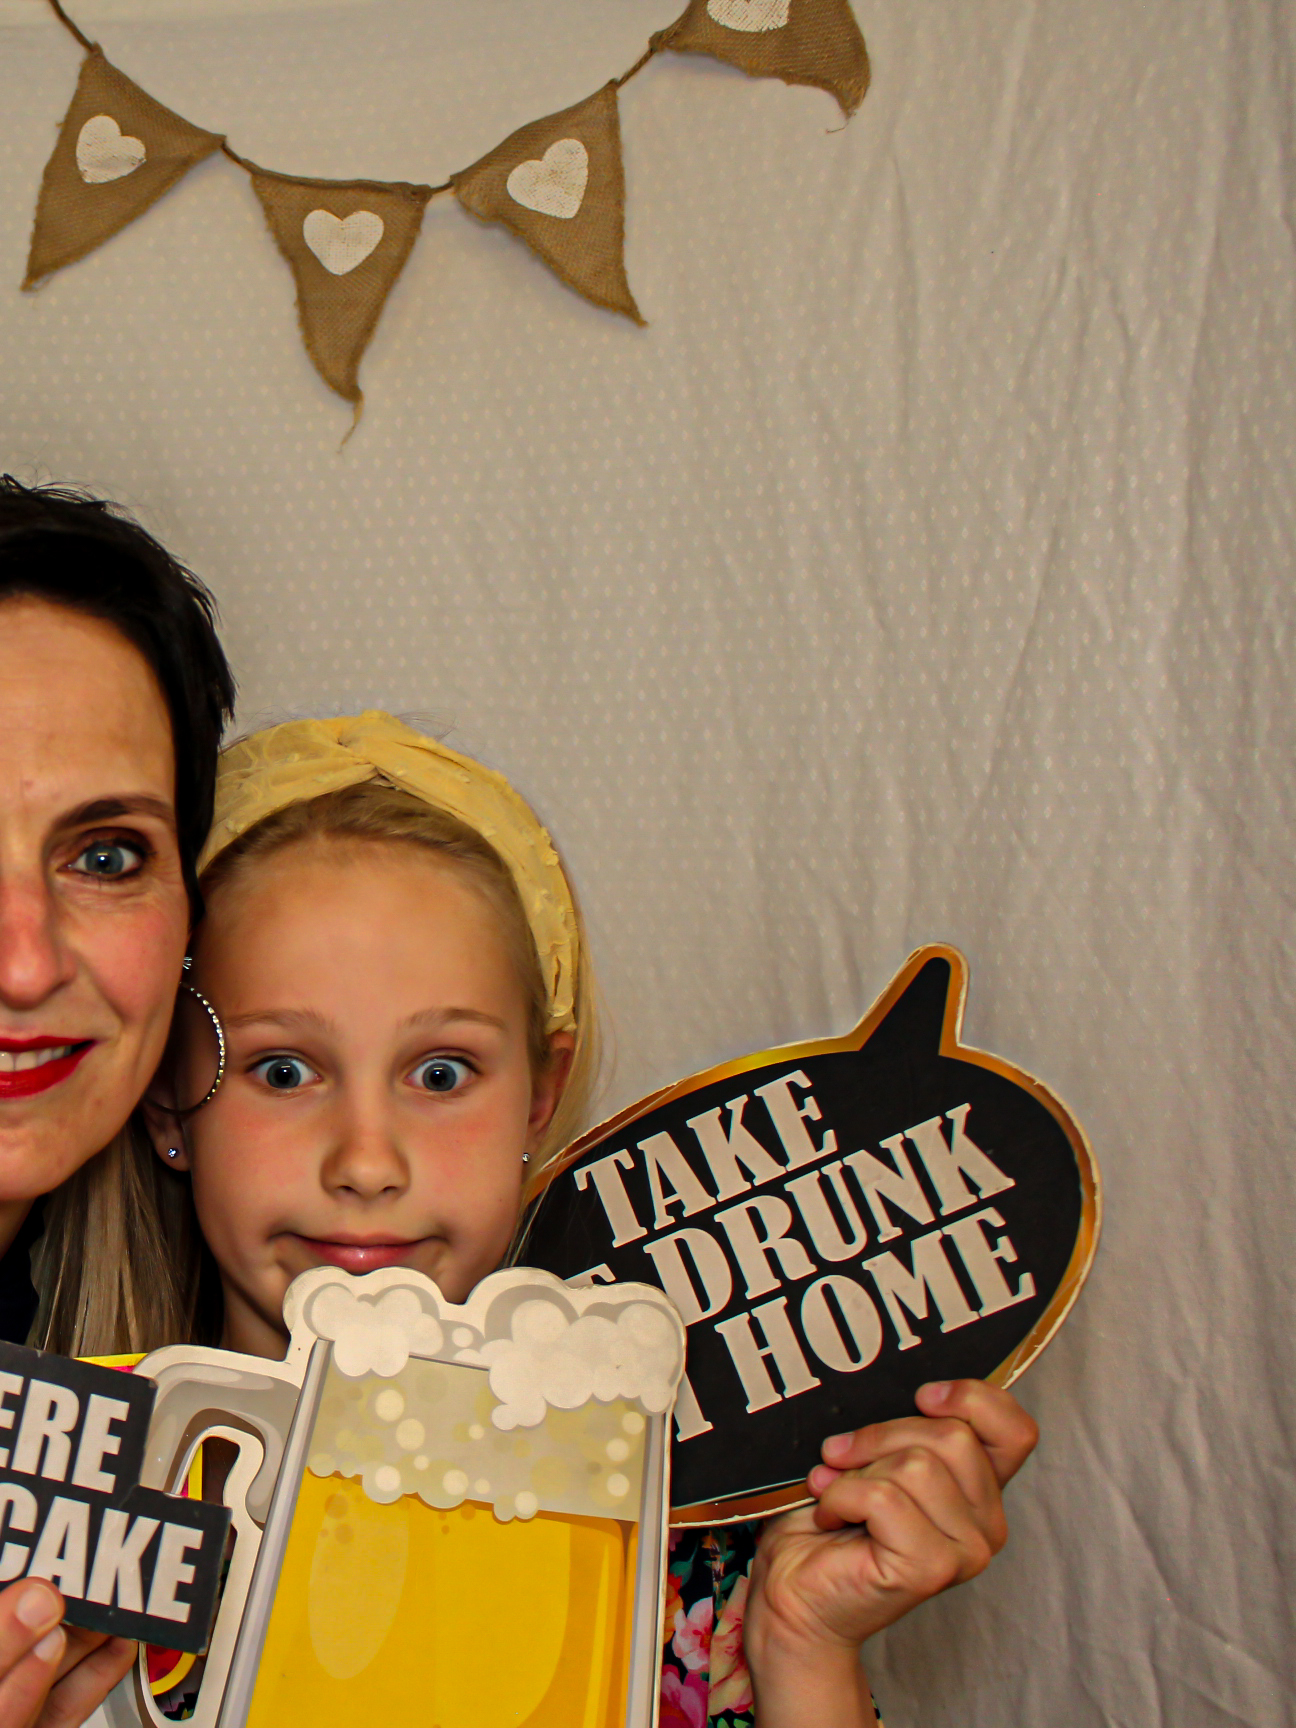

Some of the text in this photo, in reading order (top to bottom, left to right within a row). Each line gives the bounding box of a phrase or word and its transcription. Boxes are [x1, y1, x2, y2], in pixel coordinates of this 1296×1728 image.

[573, 1069, 838, 1249] TAKE
[643, 1102, 1016, 1327] DRUNK
[714, 1206, 1037, 1414] HOME
